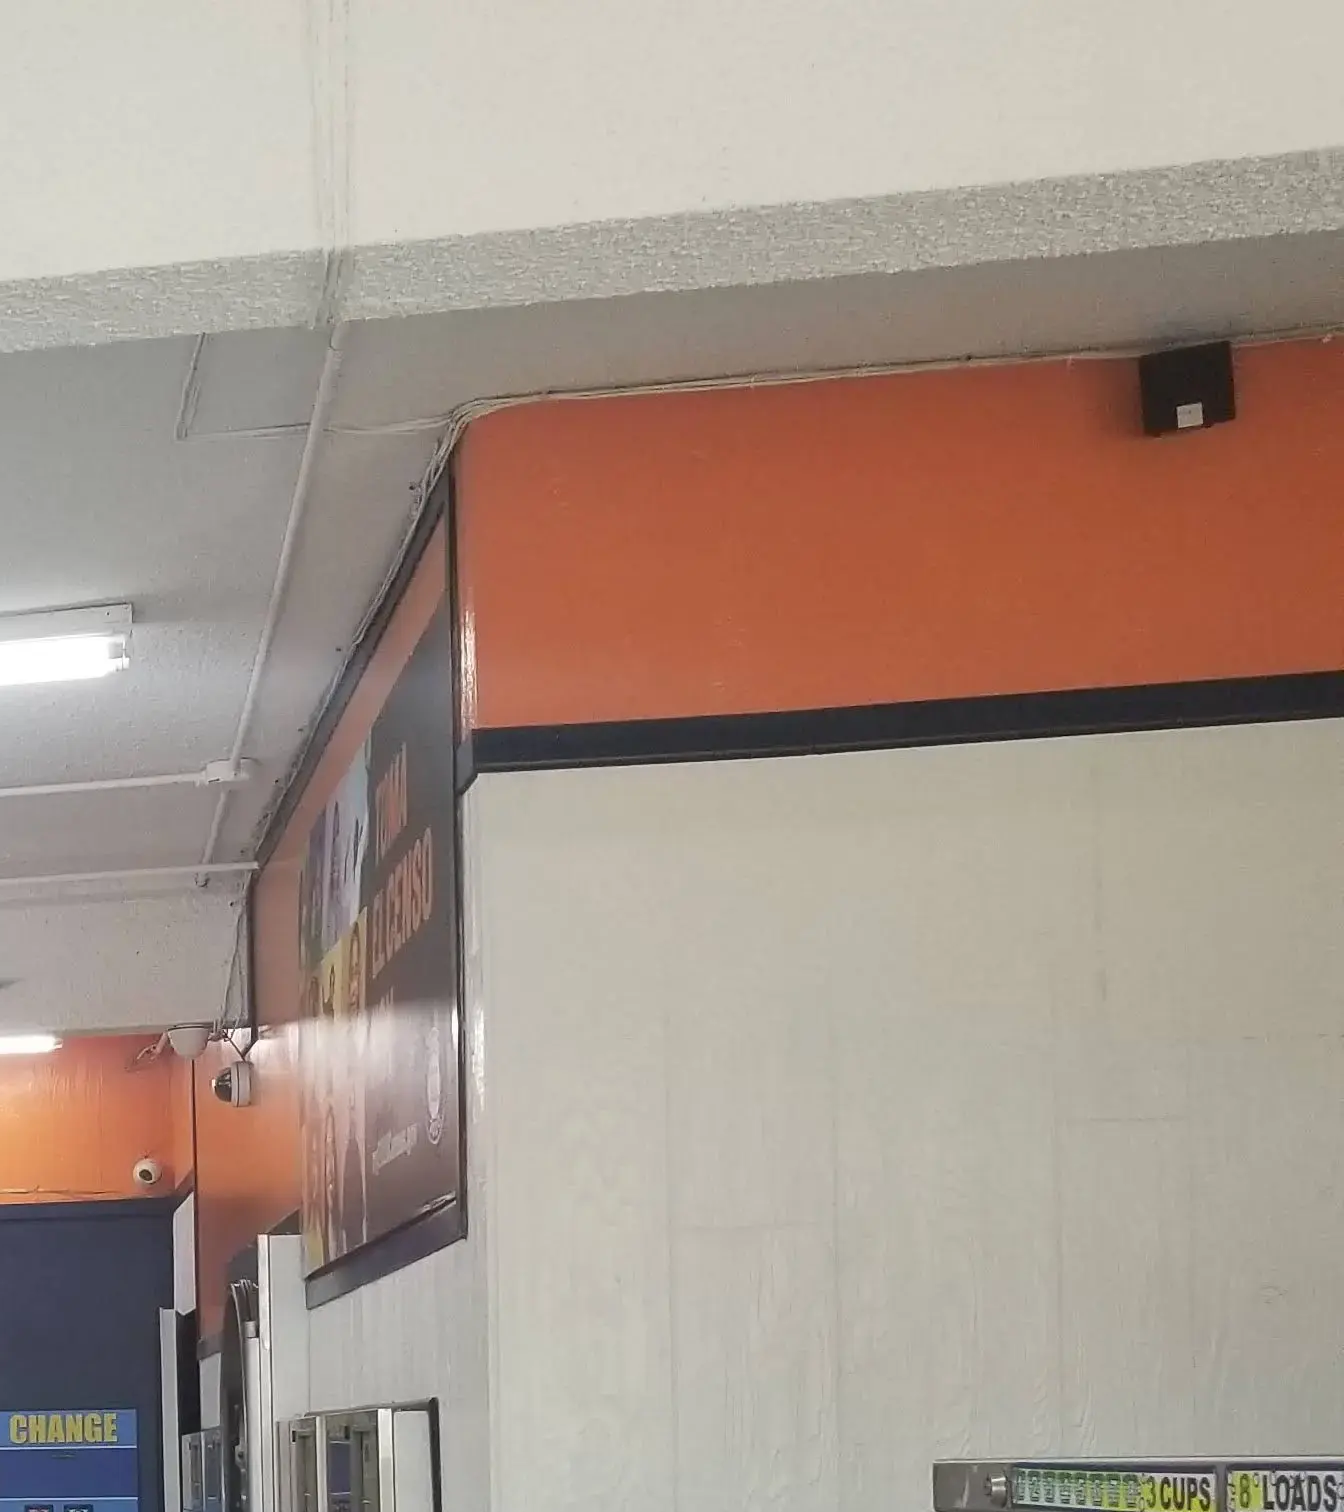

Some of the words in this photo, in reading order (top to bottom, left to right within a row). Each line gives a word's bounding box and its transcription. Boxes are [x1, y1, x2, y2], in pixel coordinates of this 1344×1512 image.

[386, 826, 434, 963] CENSO
[9, 1412, 118, 1444] CHANGE
[1145, 1475, 1156, 1508] 3
[1159, 1475, 1212, 1512] CUPS
[1239, 1473, 1251, 1508] 8
[1262, 1474, 1337, 1512] LOADS
